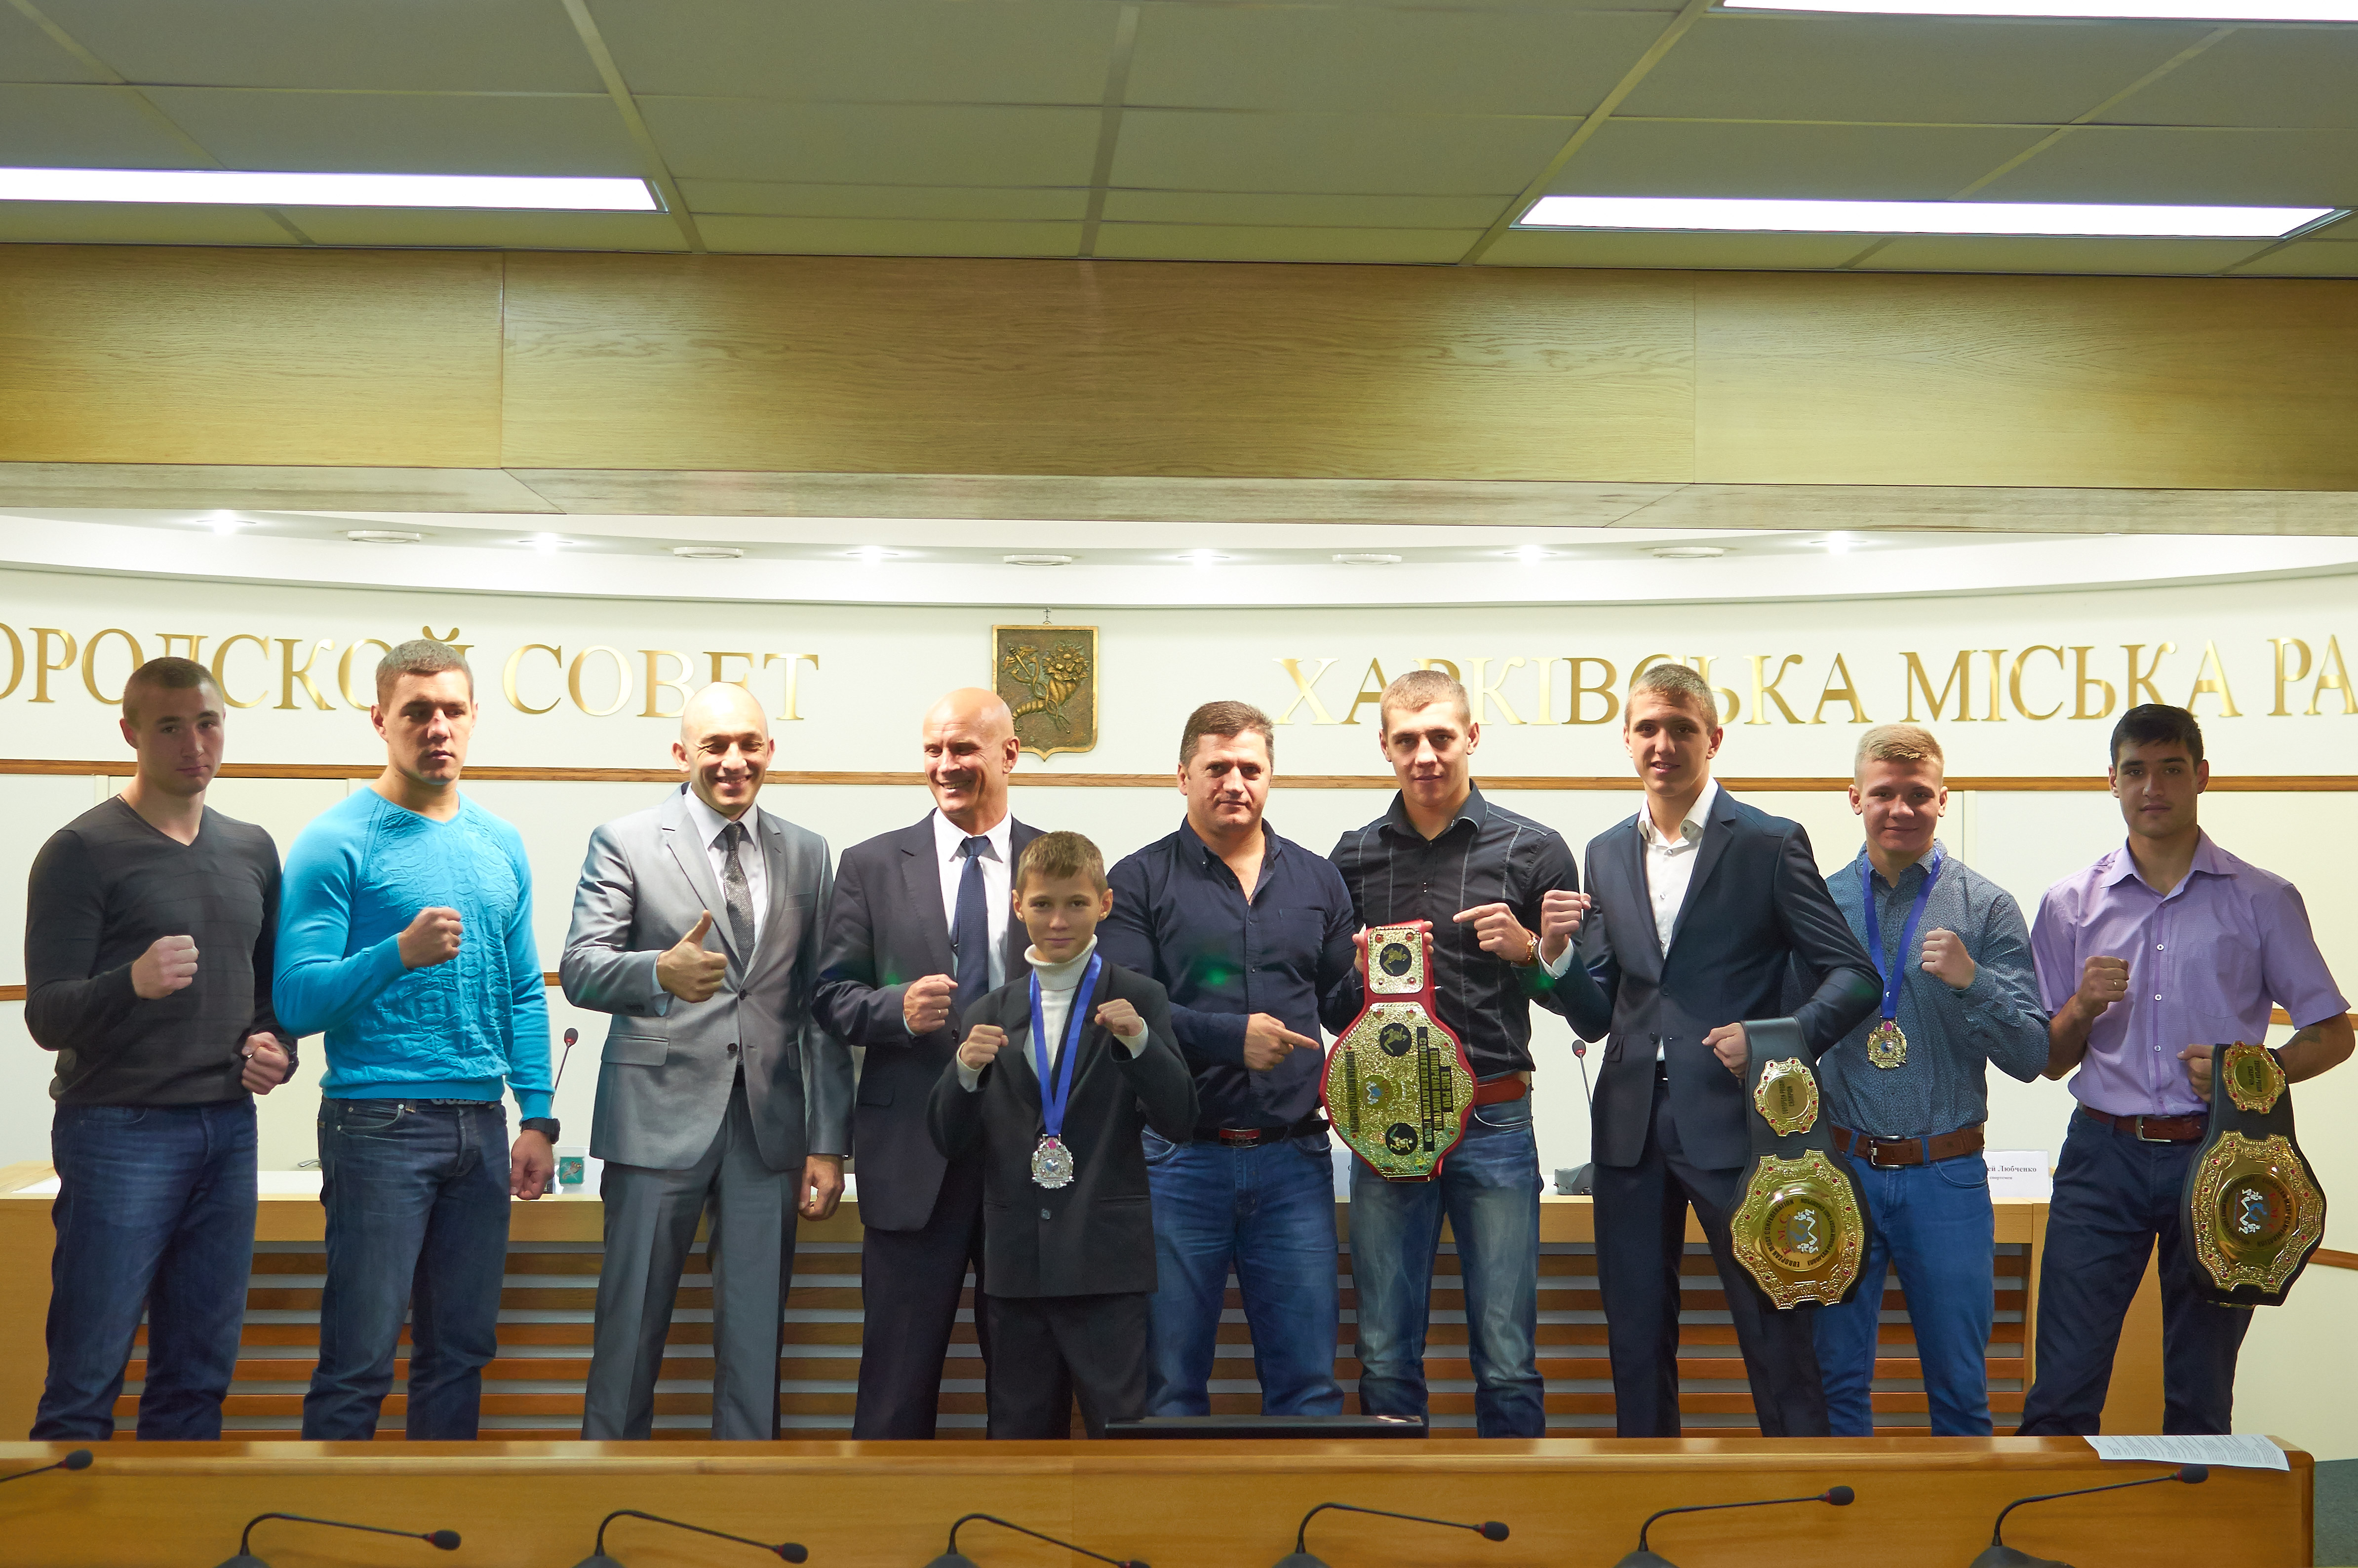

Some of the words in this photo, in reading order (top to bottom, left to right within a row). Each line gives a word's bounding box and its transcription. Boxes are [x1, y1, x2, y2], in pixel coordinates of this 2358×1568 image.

[1899, 640, 2243, 722] МІСЬКА
[1419, 1037, 1431, 1119] CONFEDERATION
[1430, 1050, 1440, 1089] EUROPEAN
[1441, 1071, 1451, 1089] EMC
[1442, 1091, 1452, 1107] PRO
[1764, 1199, 1794, 1235] CONFEDERATION
[1765, 1236, 1775, 1251] MUAY
[1772, 1251, 1800, 1267] EUROPEAN
